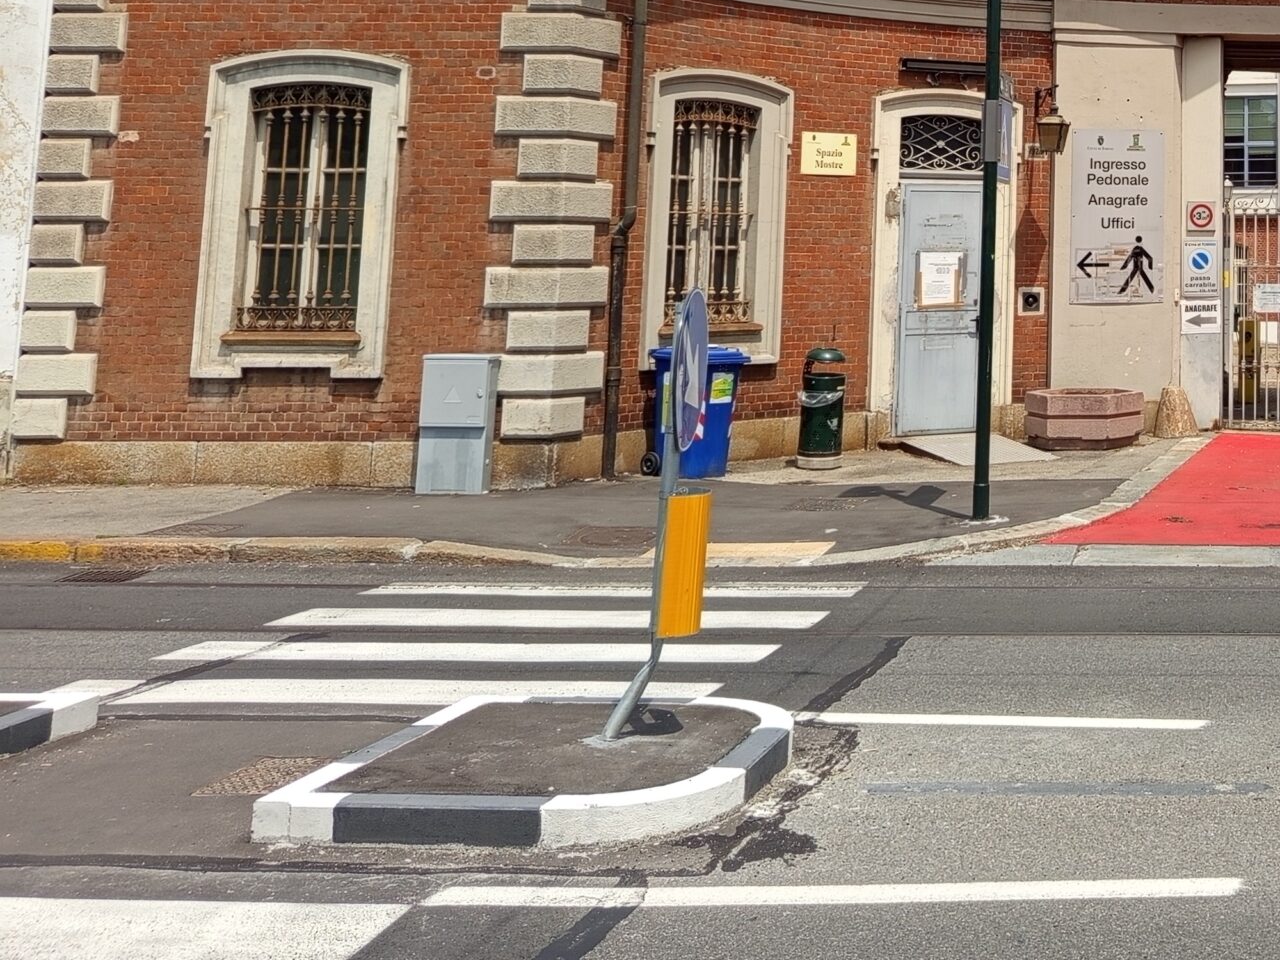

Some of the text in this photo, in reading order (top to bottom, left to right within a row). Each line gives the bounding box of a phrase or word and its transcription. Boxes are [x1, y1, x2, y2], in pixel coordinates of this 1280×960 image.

[815, 148, 843, 158] Spazio
[814, 160, 844, 169] Mostre
[1090, 158, 1146, 172] Ingresso
[1087, 173, 1149, 186] Pedonale
[1088, 194, 1148, 208] Anagrafe
[1101, 217, 1135, 229] Uffici
[1184, 304, 1217, 312] ANAGRAFE
